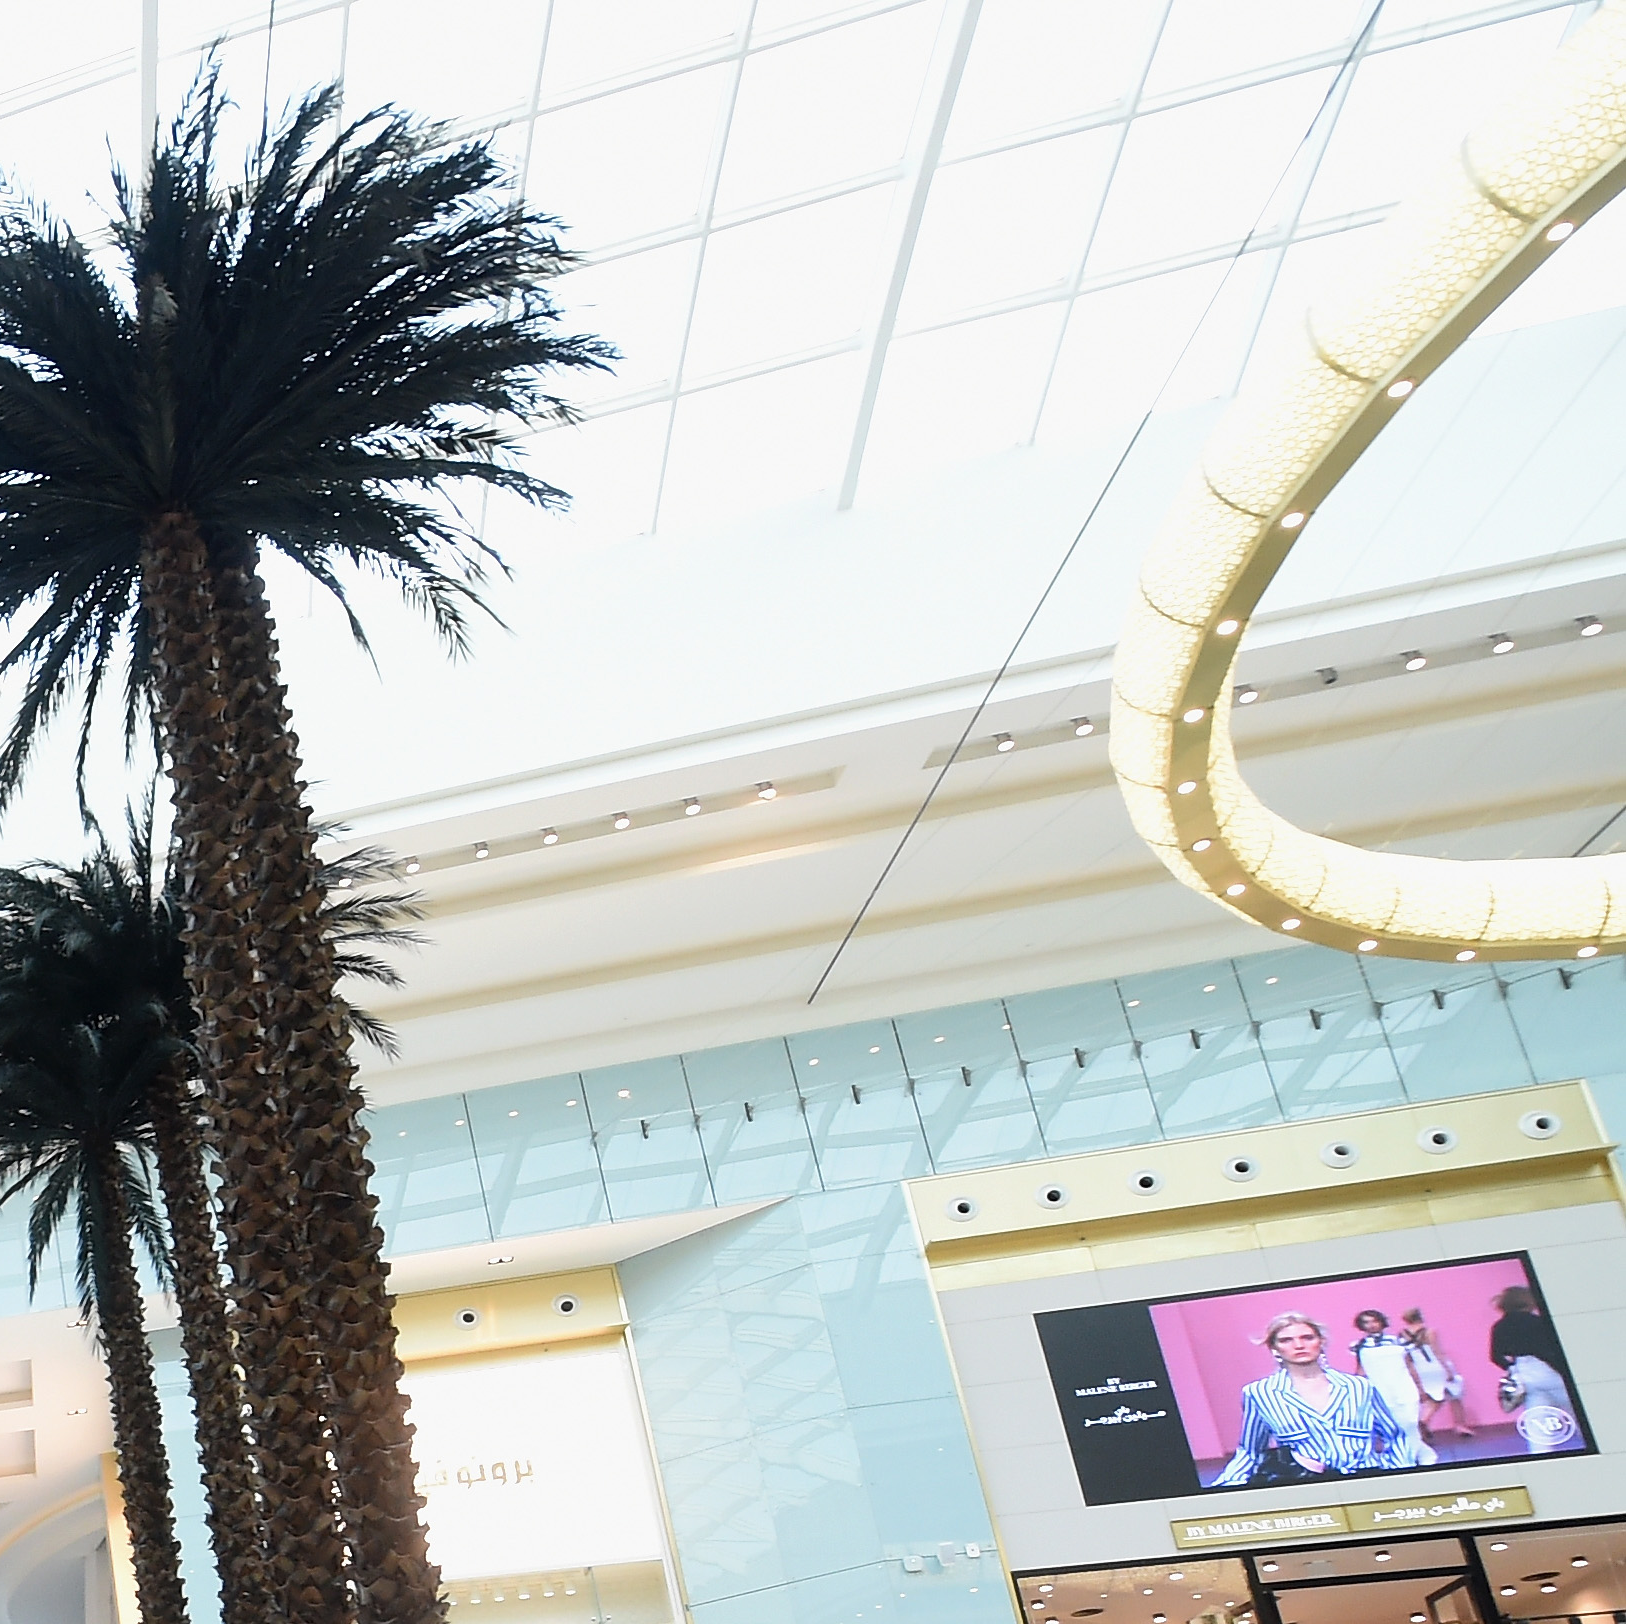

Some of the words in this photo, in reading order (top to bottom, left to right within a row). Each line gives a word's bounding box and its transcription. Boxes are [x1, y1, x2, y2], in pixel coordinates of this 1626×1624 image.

[1186, 1526, 1206, 1538] BY
[1207, 1519, 1273, 1535] MALENE
[1275, 1513, 1335, 1530] BIRGER
